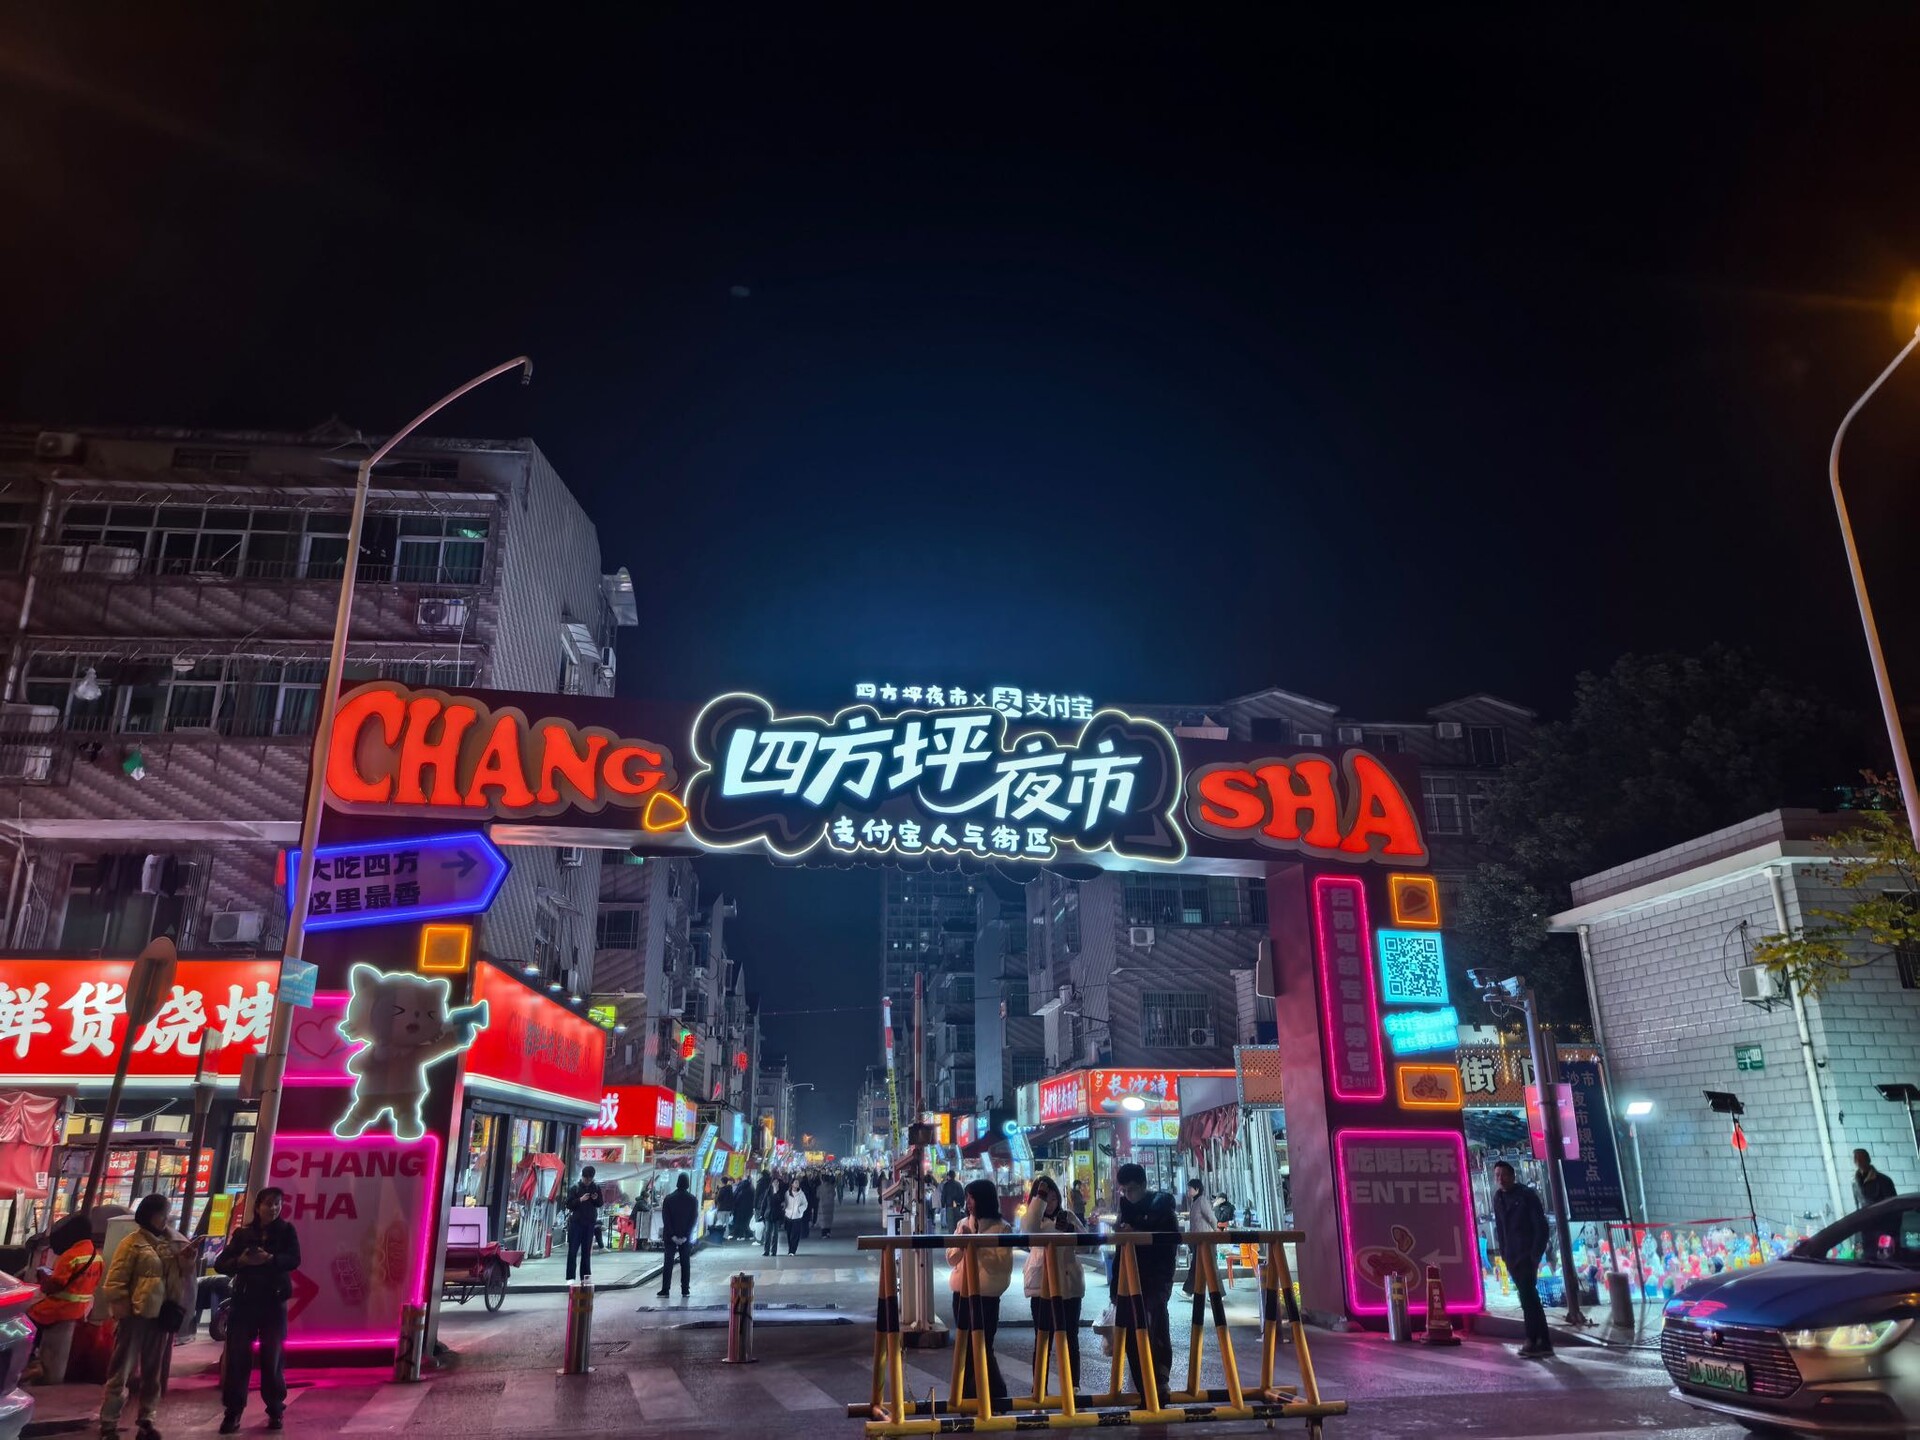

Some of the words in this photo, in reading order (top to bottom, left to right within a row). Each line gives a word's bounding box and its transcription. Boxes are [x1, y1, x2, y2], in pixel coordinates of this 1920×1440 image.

[856, 683, 967, 706] 四方坪夜市
[1026, 694, 1094, 720] 支付宝
[325, 689, 663, 808] CHANG
[722, 714, 1143, 831] 四方坪夜市
[1200, 754, 1424, 856] SHA
[831, 815, 1054, 854] 支付宝人气街区
[308, 881, 420, 916] 这里最香
[0, 981, 277, 1058] 鲜货烧烤
[1561, 1071, 1595, 1088] 沙市
[270, 1151, 429, 1179] CHANG
[1350, 1180, 1460, 1204] ENTER
